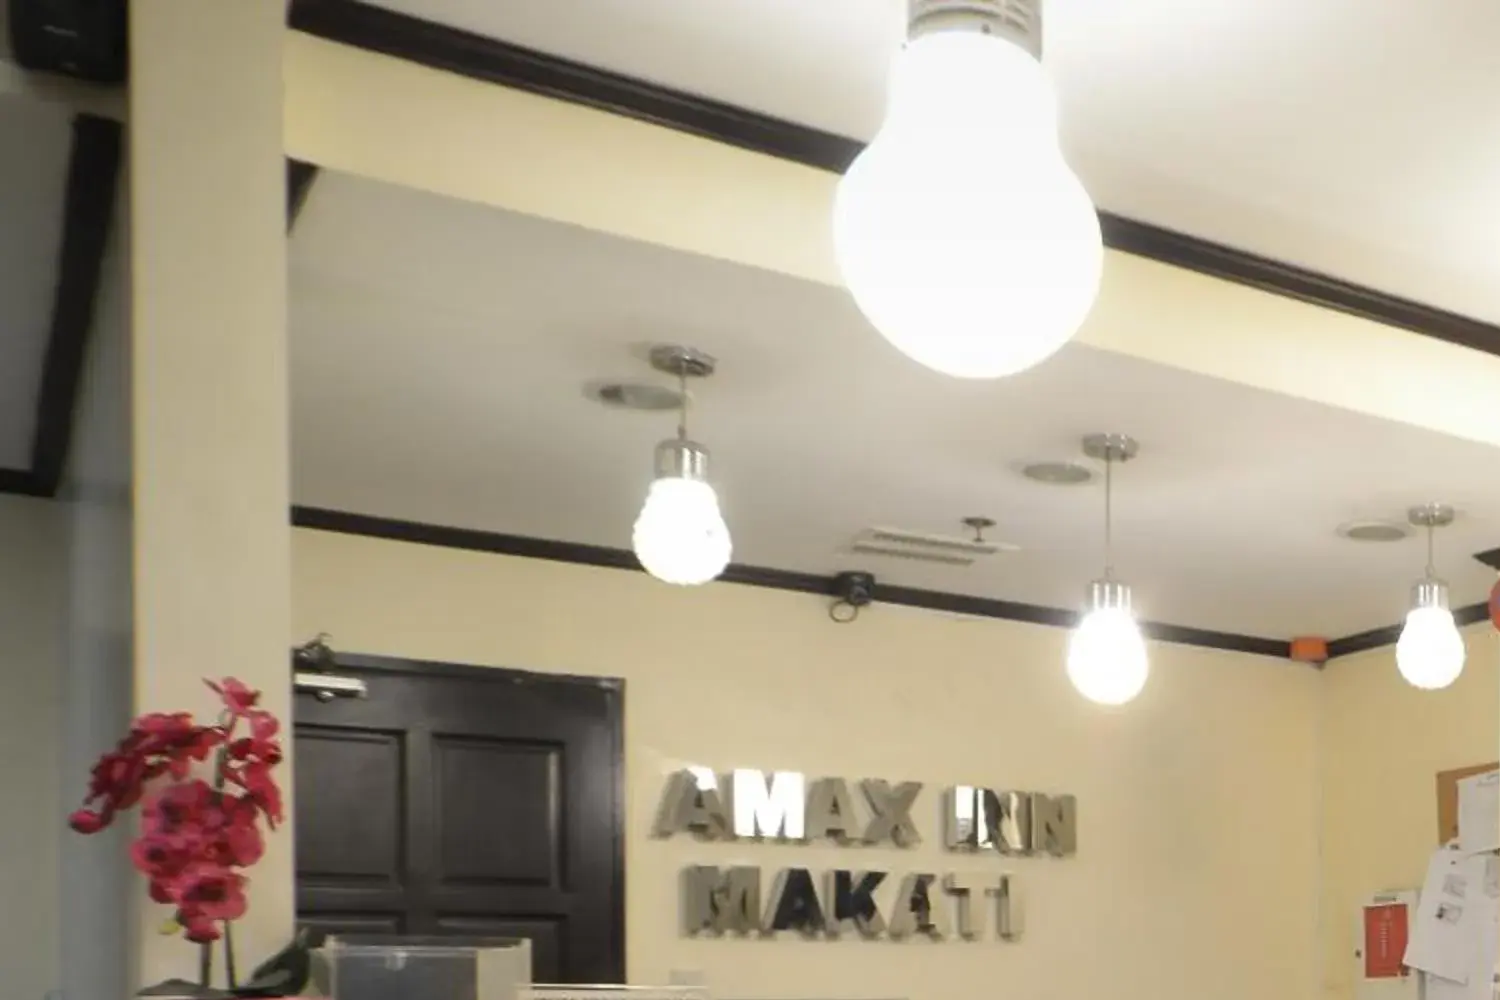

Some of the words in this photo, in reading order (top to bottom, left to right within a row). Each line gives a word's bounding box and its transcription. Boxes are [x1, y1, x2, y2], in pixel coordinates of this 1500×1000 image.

[651, 766, 923, 848] AMAX
[941, 785, 1078, 857] INN
[679, 864, 1024, 942] MAKATI
